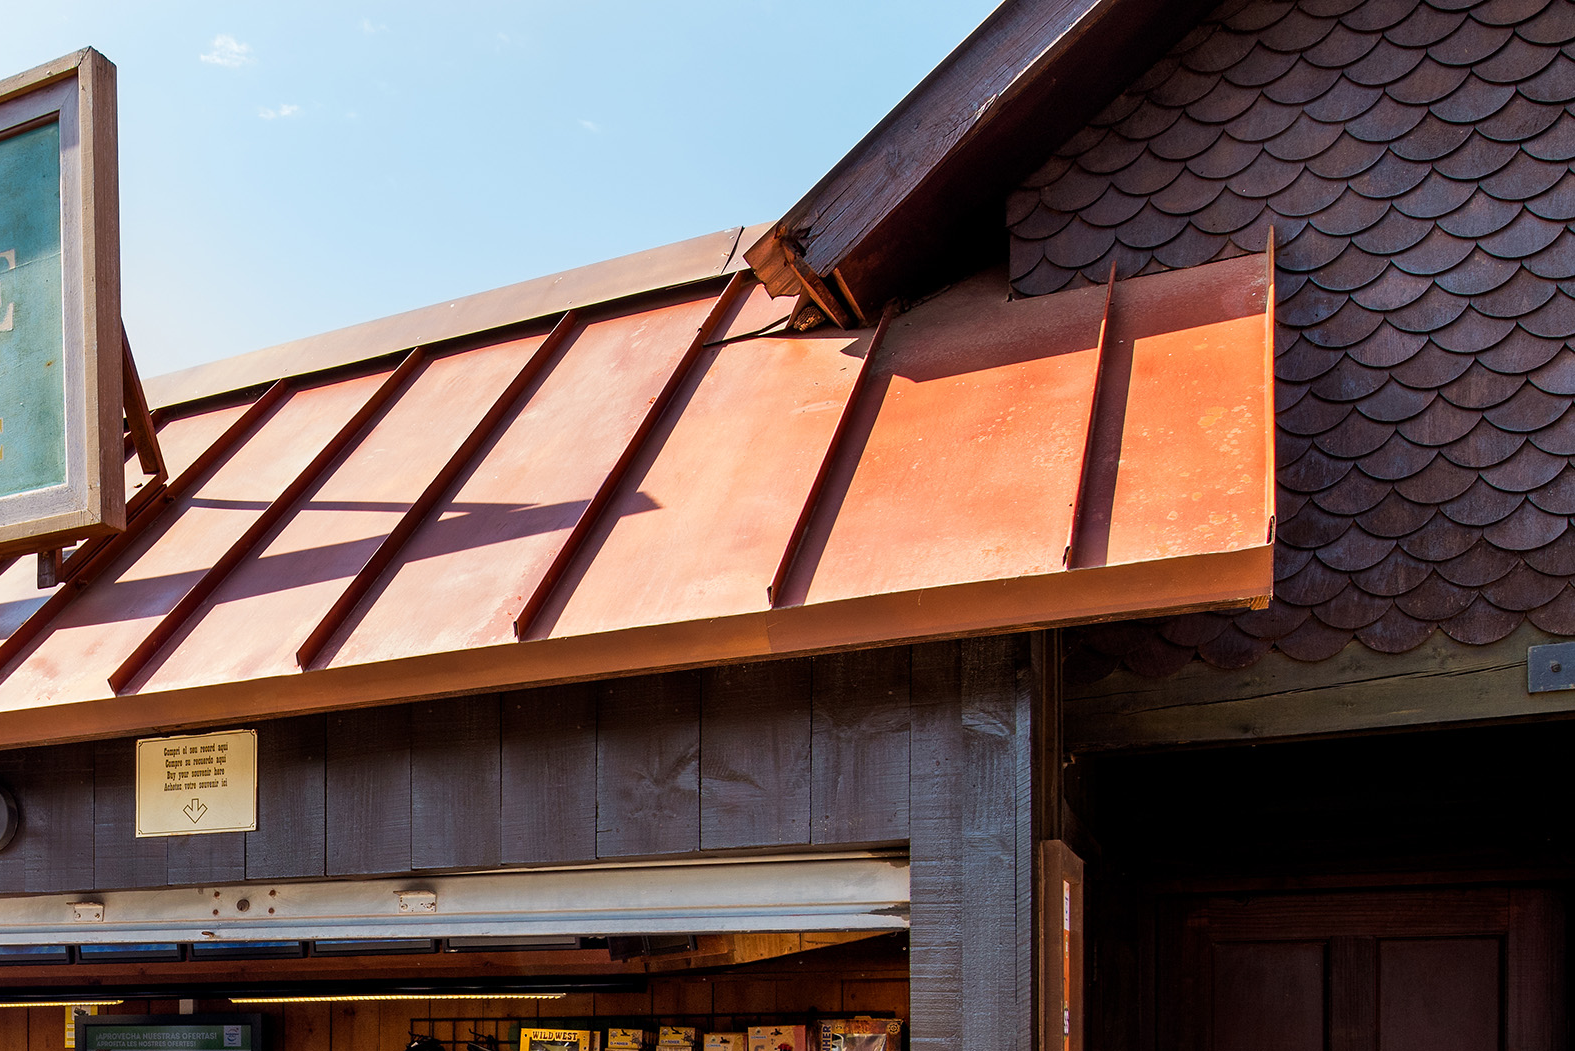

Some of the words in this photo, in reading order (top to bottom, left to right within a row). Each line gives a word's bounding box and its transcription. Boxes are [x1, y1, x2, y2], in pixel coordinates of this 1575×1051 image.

[167, 771, 176, 781] Buy
[178, 771, 189, 781] your
[191, 767, 212, 778] souvenir
[214, 767, 225, 776] here
[199, 779, 219, 789] souvenir
[142, 1032, 181, 1040] NUESTRAS
[182, 1032, 217, 1040] OFERTAS!
[532, 1031, 554, 1041] WILD
[555, 1031, 578, 1041] WEST
